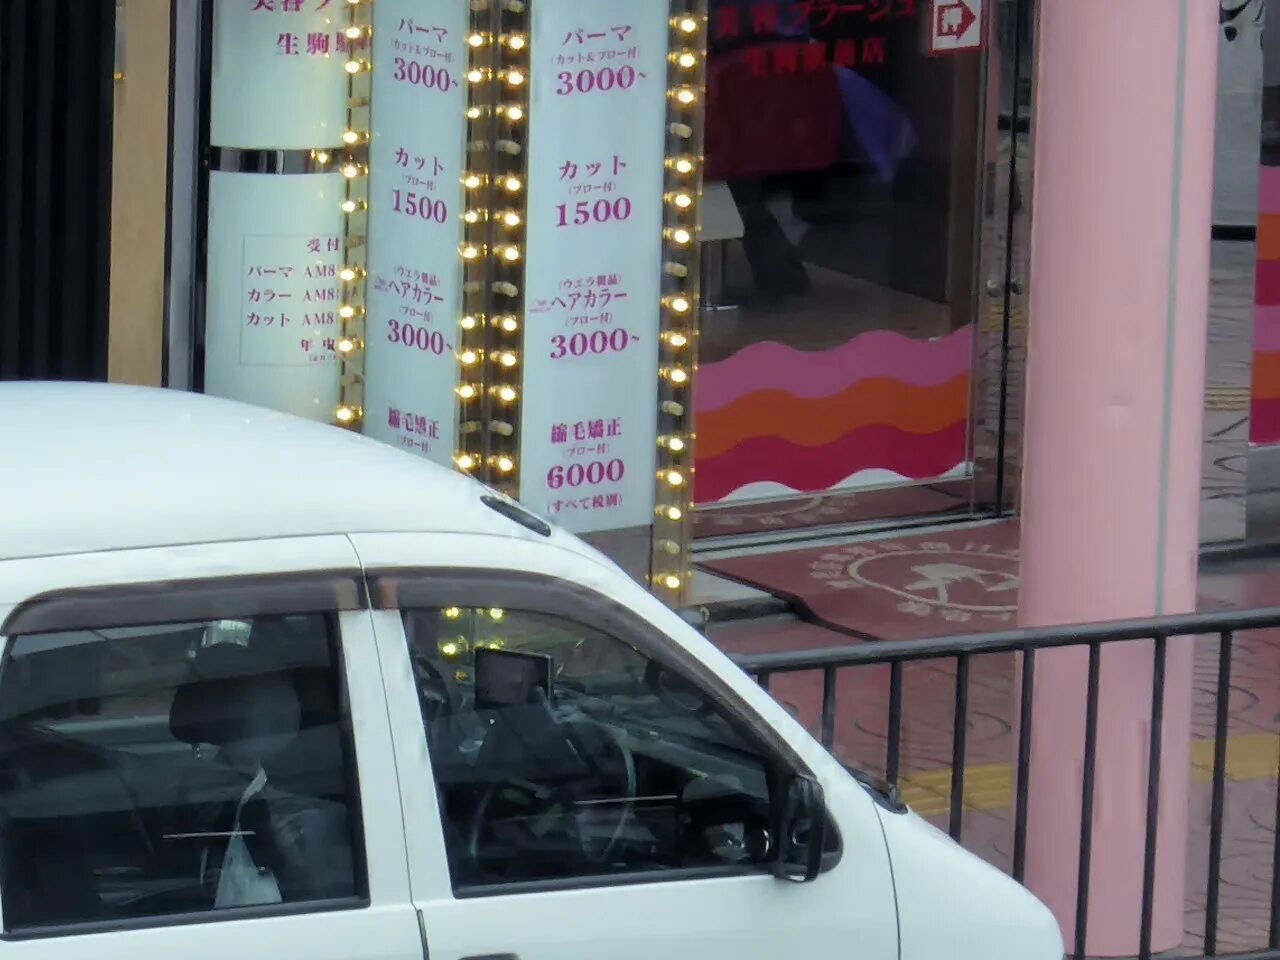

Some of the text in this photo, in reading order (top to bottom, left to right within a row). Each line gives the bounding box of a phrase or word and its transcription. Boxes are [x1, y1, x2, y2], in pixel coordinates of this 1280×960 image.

[395, 147, 444, 176] カット
[559, 155, 627, 181] カット
[392, 189, 447, 224] 1500
[556, 197, 631, 228] 1500
[247, 287, 293, 303] カラー
[246, 311, 291, 327] カット
[547, 458, 625, 489] 6000
